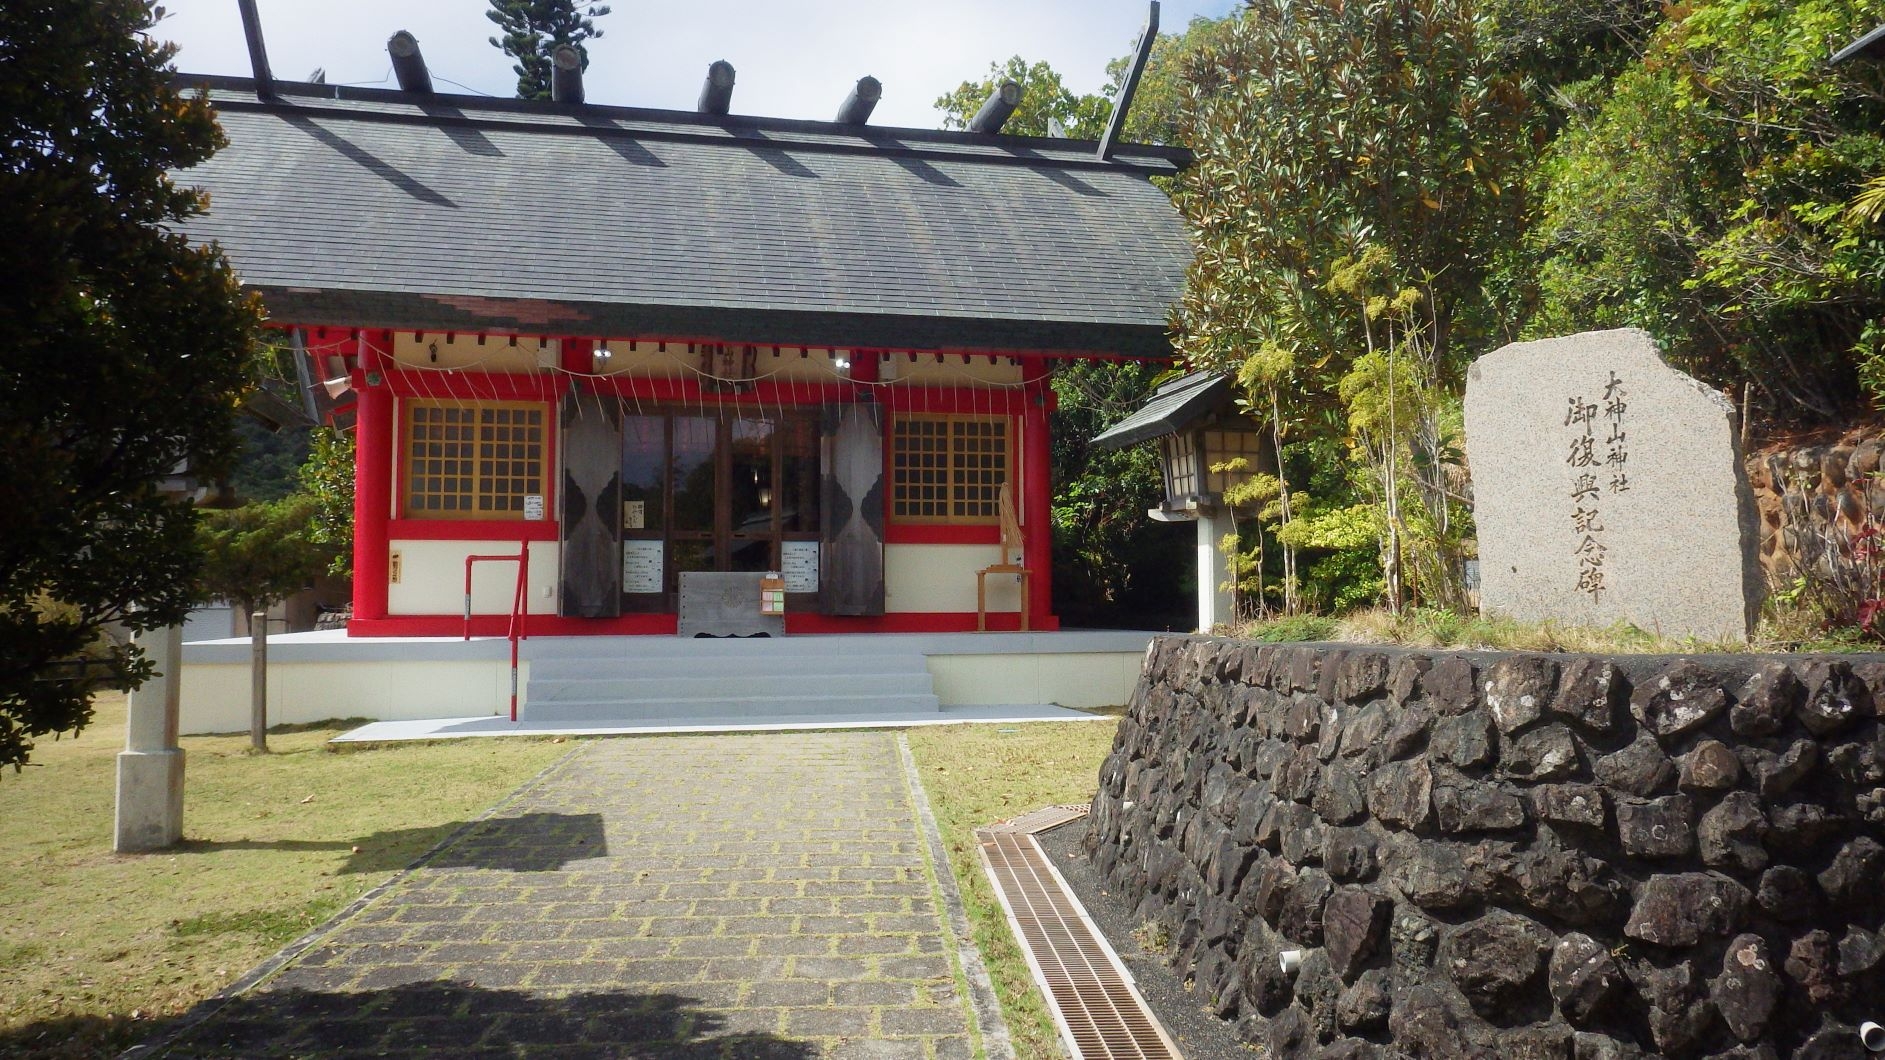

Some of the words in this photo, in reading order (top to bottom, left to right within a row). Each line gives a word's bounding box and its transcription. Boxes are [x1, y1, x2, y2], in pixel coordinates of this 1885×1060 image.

[1565, 396, 1608, 605] 御復興記念碑
[1602, 370, 1631, 494] 大神山神社
